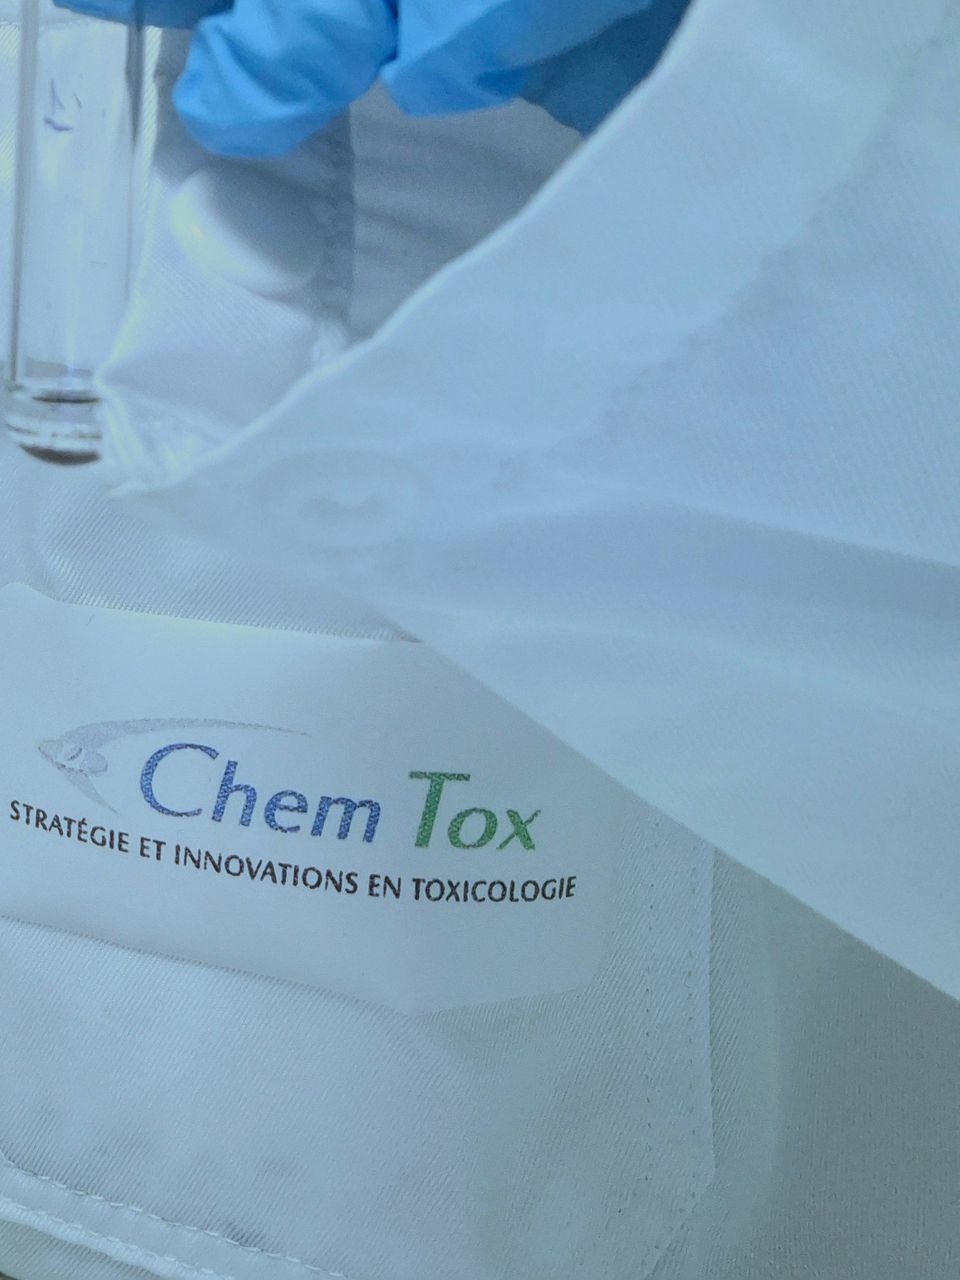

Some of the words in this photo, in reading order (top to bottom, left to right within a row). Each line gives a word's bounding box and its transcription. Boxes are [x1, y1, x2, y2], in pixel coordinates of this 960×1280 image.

[140, 743, 381, 844] Chem
[409, 771, 541, 851] Tox
[10, 800, 129, 853] STRATÉGIE
[140, 837, 166, 861] ET
[174, 844, 358, 894] INNOVATIONS
[368, 874, 401, 899] EN
[412, 876, 576, 903] TOXICOLOGIE
